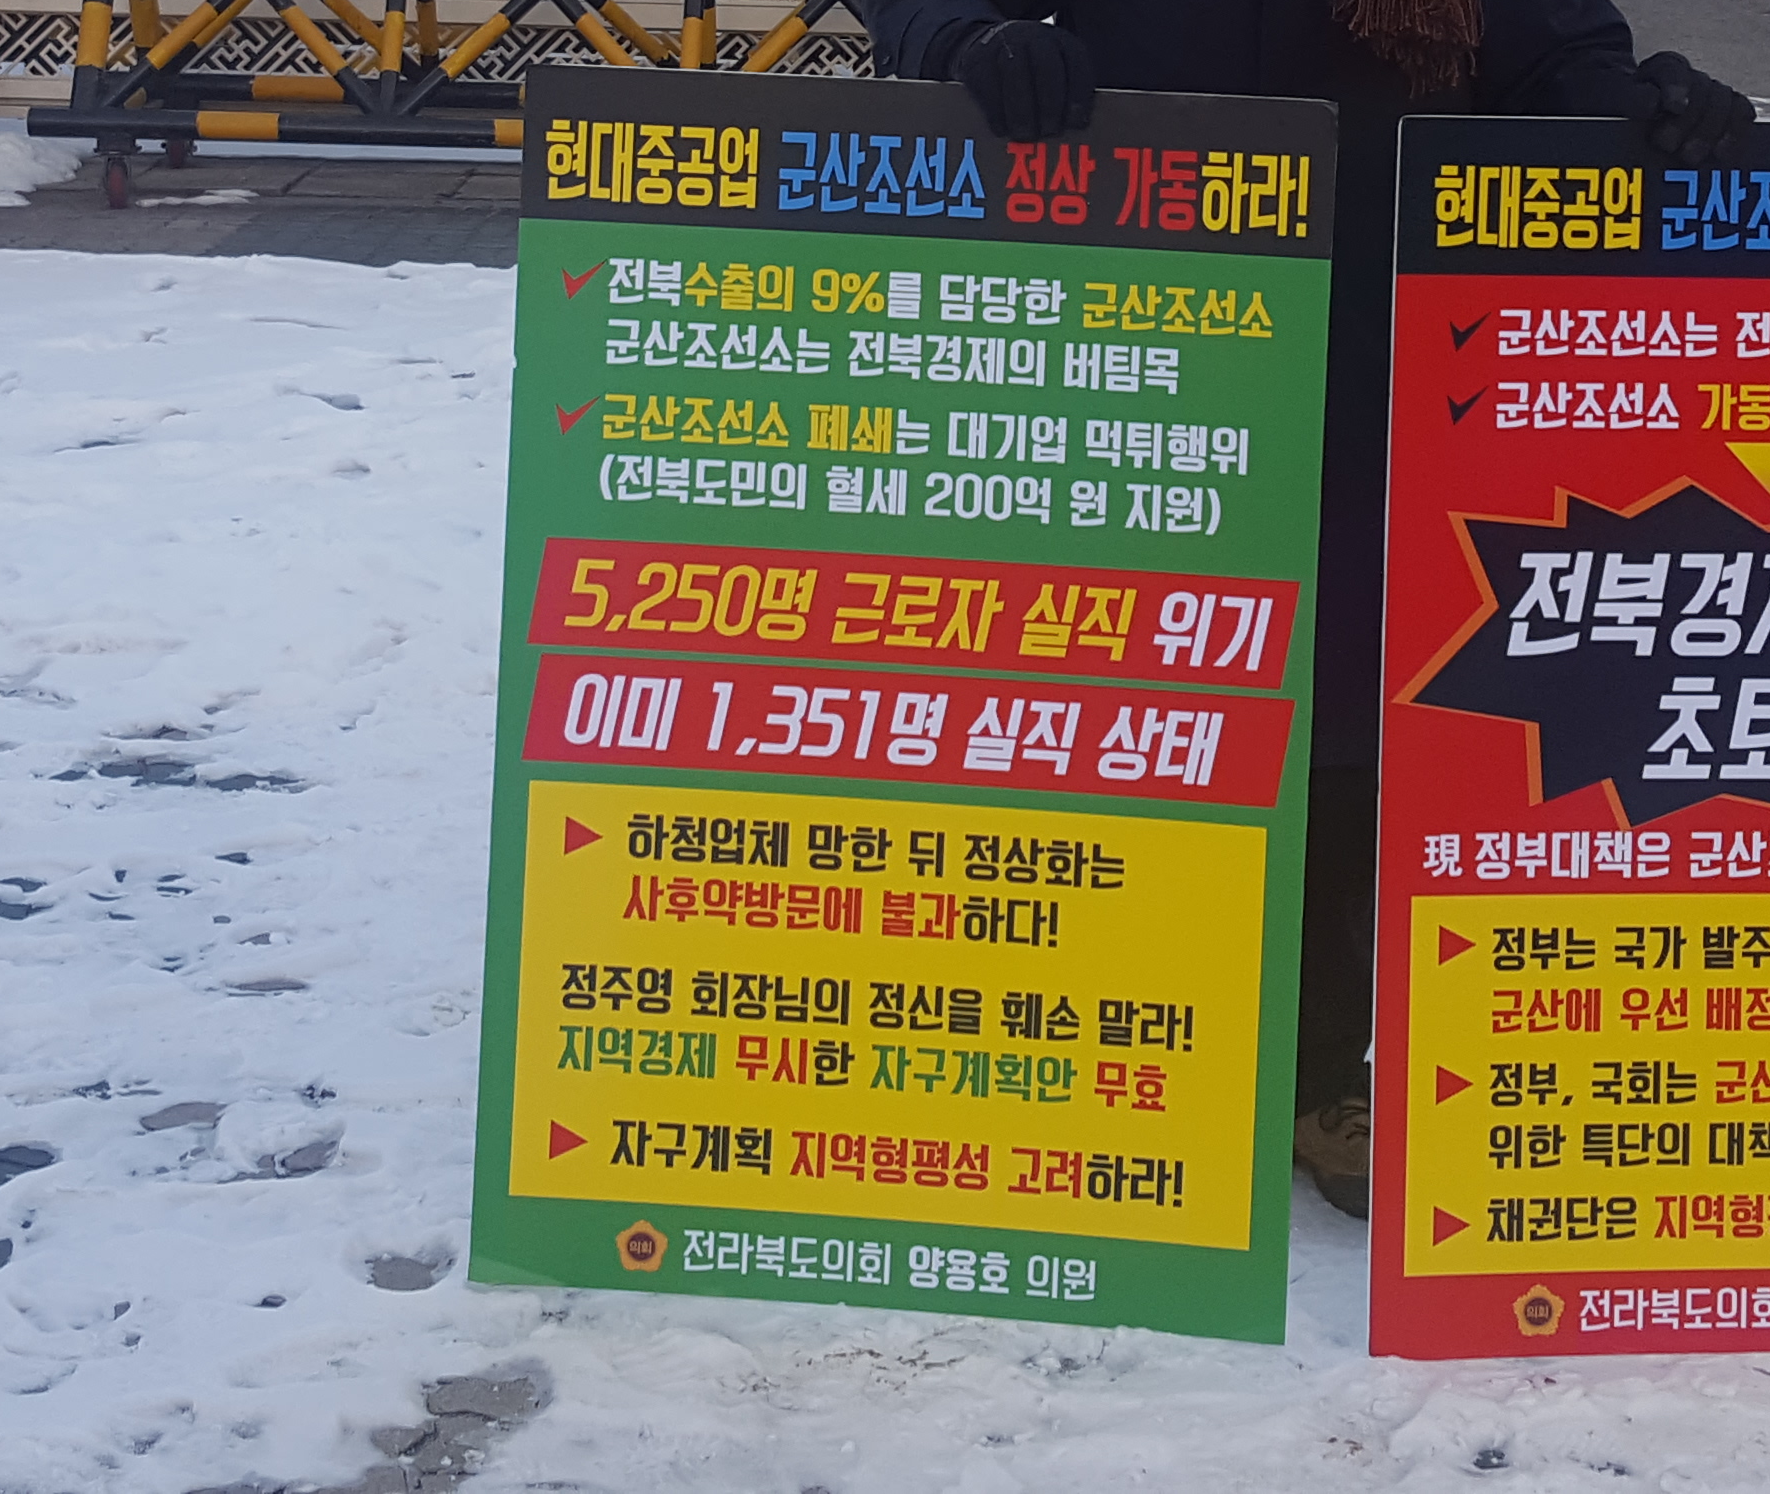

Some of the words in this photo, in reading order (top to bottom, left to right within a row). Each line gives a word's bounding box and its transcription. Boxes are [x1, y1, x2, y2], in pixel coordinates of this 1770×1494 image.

[545, 119, 759, 209] 현대중공업
[778, 131, 985, 219] 군산조선소
[1005, 143, 1096, 225] 정상
[1112, 143, 1310, 238] 가동하라!
[1434, 164, 1643, 250] 현대중공업
[607, 257, 794, 312] 전북수출의
[811, 268, 922, 320] 9%를
[939, 274, 1067, 325] 담당한
[1082, 282, 1273, 338] 군산조선소
[1498, 309, 1718, 358] 군산조선소는
[605, 318, 831, 374] 군산조선소는
[848, 330, 1046, 387] 전북경제의
[1063, 342, 1179, 395] 버팀목
[602, 393, 789, 448] 군산조선소
[806, 404, 931, 455] 폐쇄는
[947, 411, 1068, 464] 대기업
[1085, 419, 1249, 476] 먹튀행위
[1496, 381, 1680, 429] 군산조선소
[599, 453, 807, 510] (전북도민의
[825, 465, 908, 516] 혈세
[924, 472, 1052, 525] 200억
[1069, 480, 1108, 527] 원
[1124, 483, 1221, 536] 지원)
[563, 558, 818, 641] 5,250명
[831, 572, 1005, 653] 근로자
[1018, 583, 1138, 662] 실직
[1153, 591, 1274, 672] 위기
[563, 673, 682, 751] 이미
[706, 681, 949, 766] 1,351명
[963, 697, 1082, 776] 실직
[1097, 706, 1224, 786] 상태
[627, 813, 790, 868] 하청업체
[807, 824, 893, 873] 망한
[908, 830, 945, 878] 뒤
[964, 834, 1125, 889] 정상화는
[1422, 833, 1463, 878] 現
[1475, 831, 1671, 880] 정부대책은
[622, 874, 863, 934] 사후약방문에
[881, 890, 1059, 948] 불과하다!
[1492, 927, 1596, 971] 정부는
[1614, 925, 1687, 970] 국가
[561, 963, 673, 1014] 정주영
[690, 970, 851, 1026] 회장님의
[869, 982, 983, 1036] 정신을
[1000, 991, 1080, 1041] 훼손
[1098, 999, 1194, 1052] 말라!
[1491, 988, 1602, 1034] 군산에
[1620, 987, 1689, 1032] 우선
[557, 1025, 717, 1079] 지역경제
[735, 1035, 856, 1086] 무시한
[869, 1044, 1078, 1103] 자구계획안
[1094, 1060, 1167, 1112] 무효
[1489, 1062, 1574, 1107] 정부,
[1591, 1060, 1697, 1105] 국회는
[610, 1120, 773, 1176] 자구계획
[789, 1130, 990, 1191] 지역형평성
[1007, 1148, 1184, 1208] 고려하라!
[1488, 1124, 1567, 1170] 위한
[1582, 1122, 1690, 1168] 특단의
[625, 1237, 655, 1257] 의회
[1486, 1196, 1637, 1242] 채권단은
[683, 1229, 892, 1285] 전라북도의회
[908, 1245, 1011, 1294] 양용호
[1025, 1255, 1096, 1301] 의원
[1524, 1304, 1553, 1321] 의회
